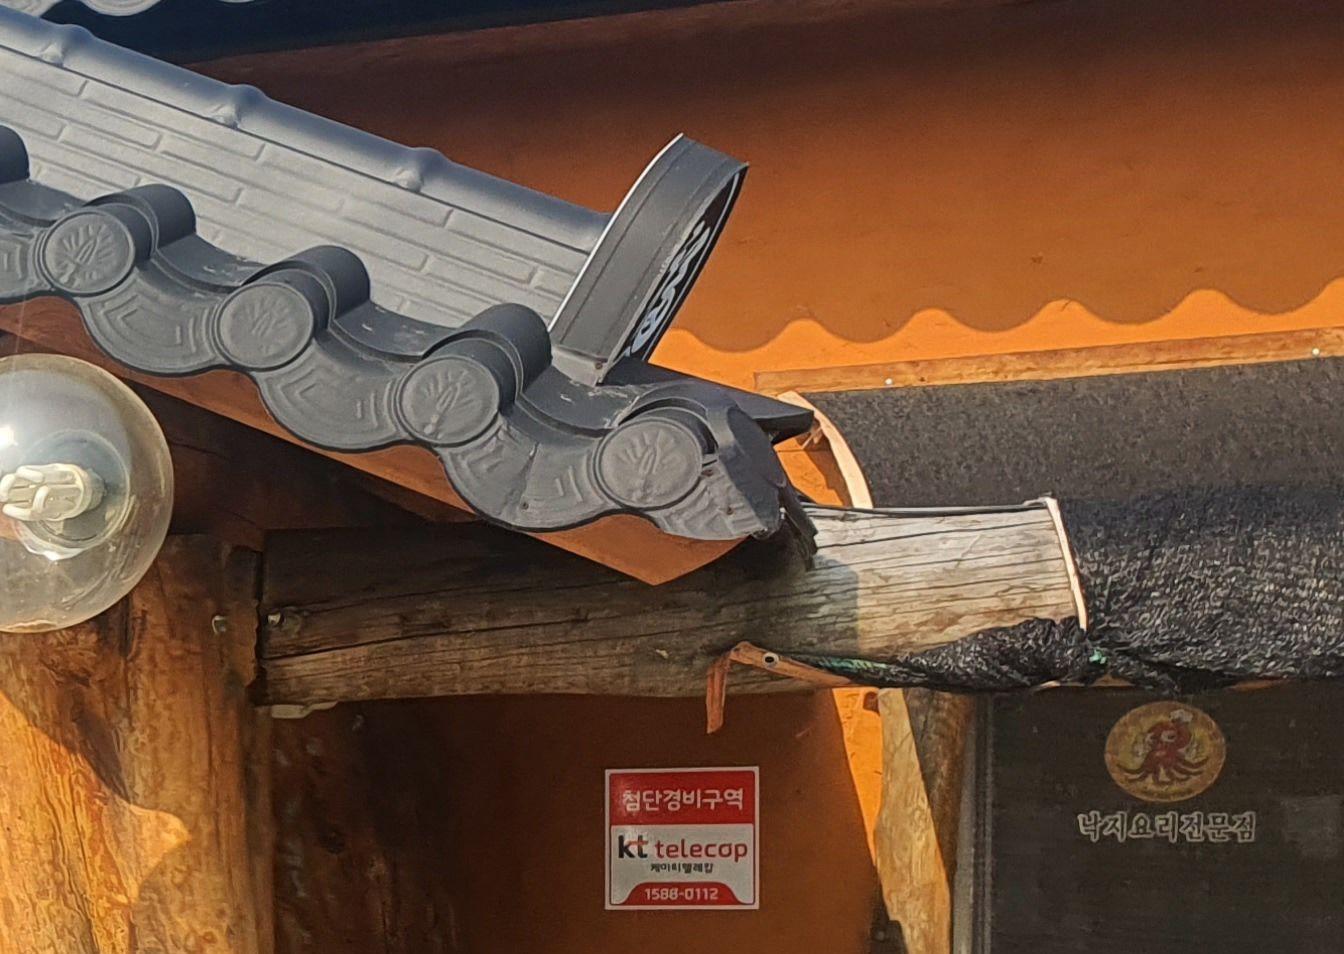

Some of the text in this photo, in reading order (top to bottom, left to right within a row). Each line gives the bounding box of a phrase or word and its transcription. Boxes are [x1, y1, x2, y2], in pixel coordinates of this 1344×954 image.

[622, 787, 744, 812] 첨단경비구역
[1076, 810, 1257, 844] 낙지요리전문점
[618, 835, 748, 863] kt telecop
[644, 887, 719, 901] 1588-0112
